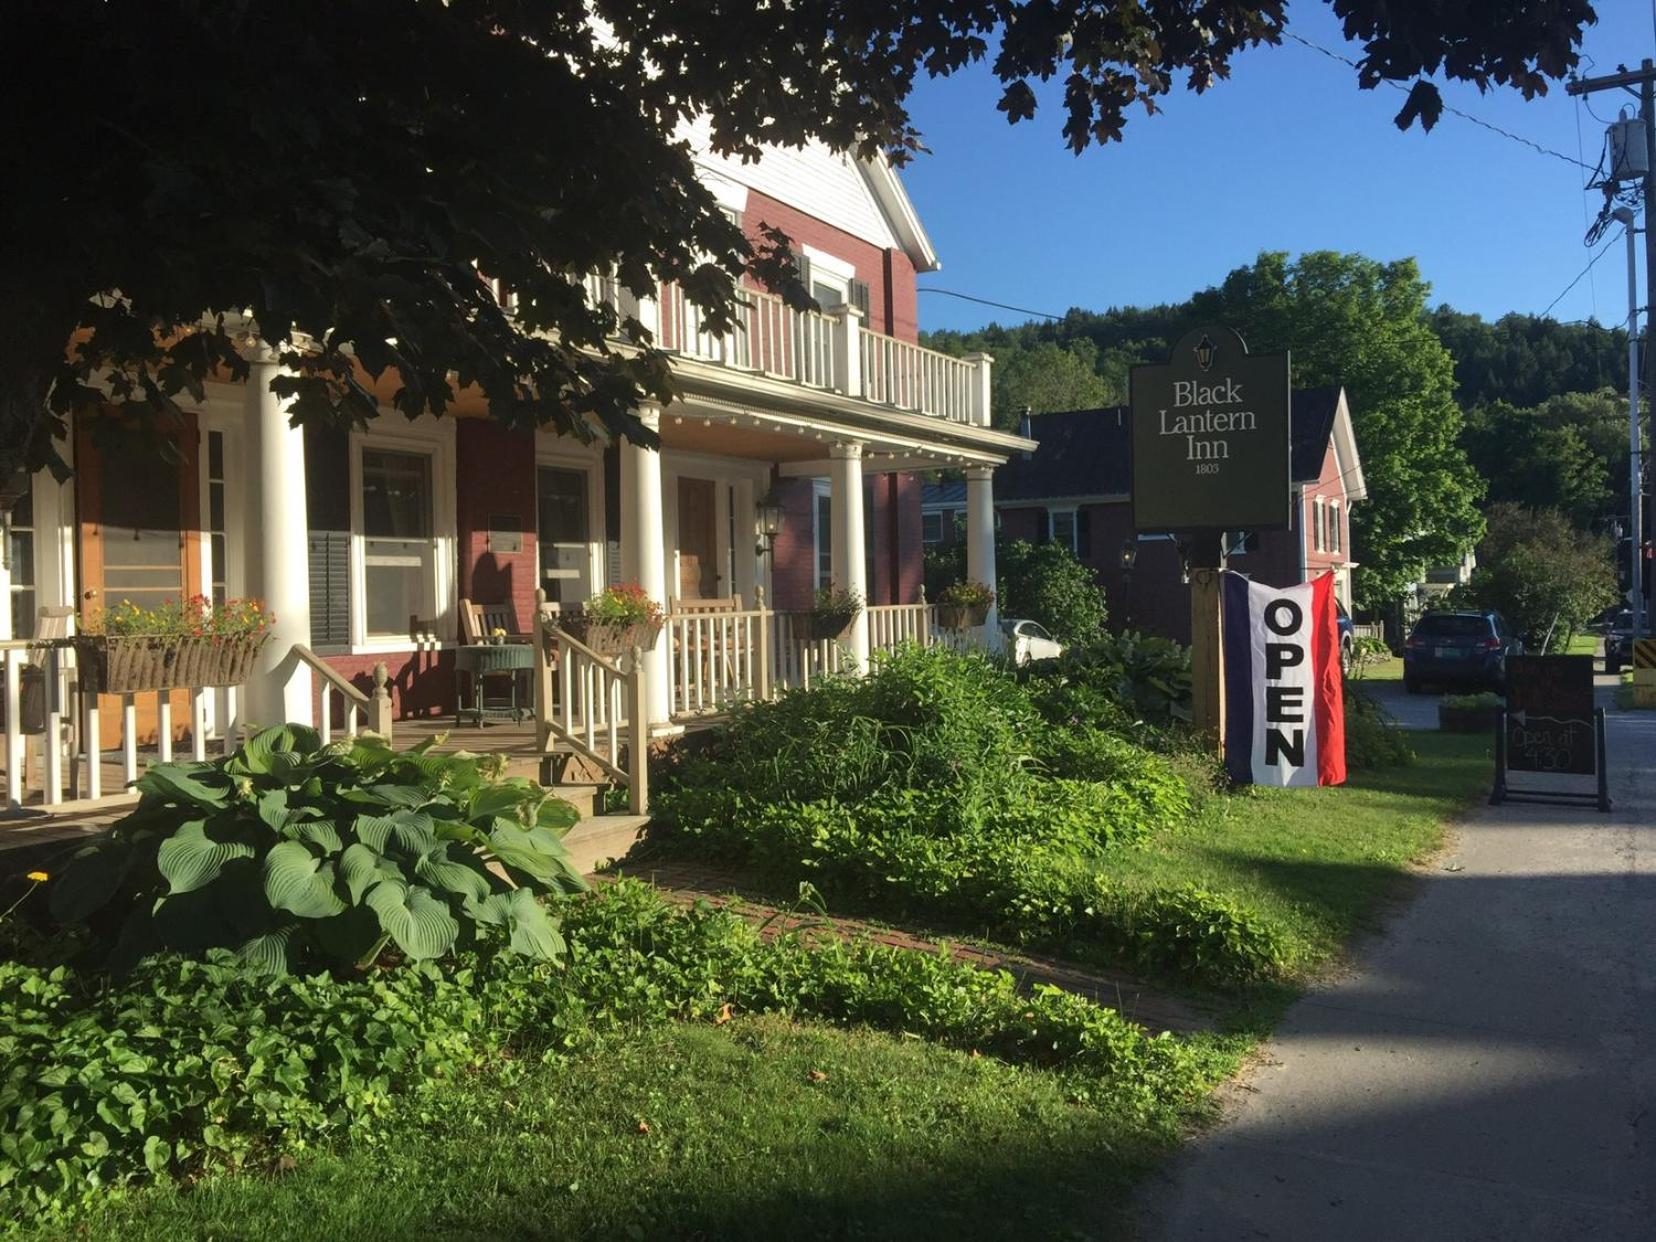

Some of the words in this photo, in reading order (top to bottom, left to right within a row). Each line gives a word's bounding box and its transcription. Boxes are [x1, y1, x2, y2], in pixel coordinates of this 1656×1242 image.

[1173, 378, 1243, 407] Black
[1159, 409, 1257, 435] Lantern
[1186, 435, 1229, 460] Inn
[1196, 463, 1219, 475] 1803
[1263, 598, 1305, 767] OPEN
